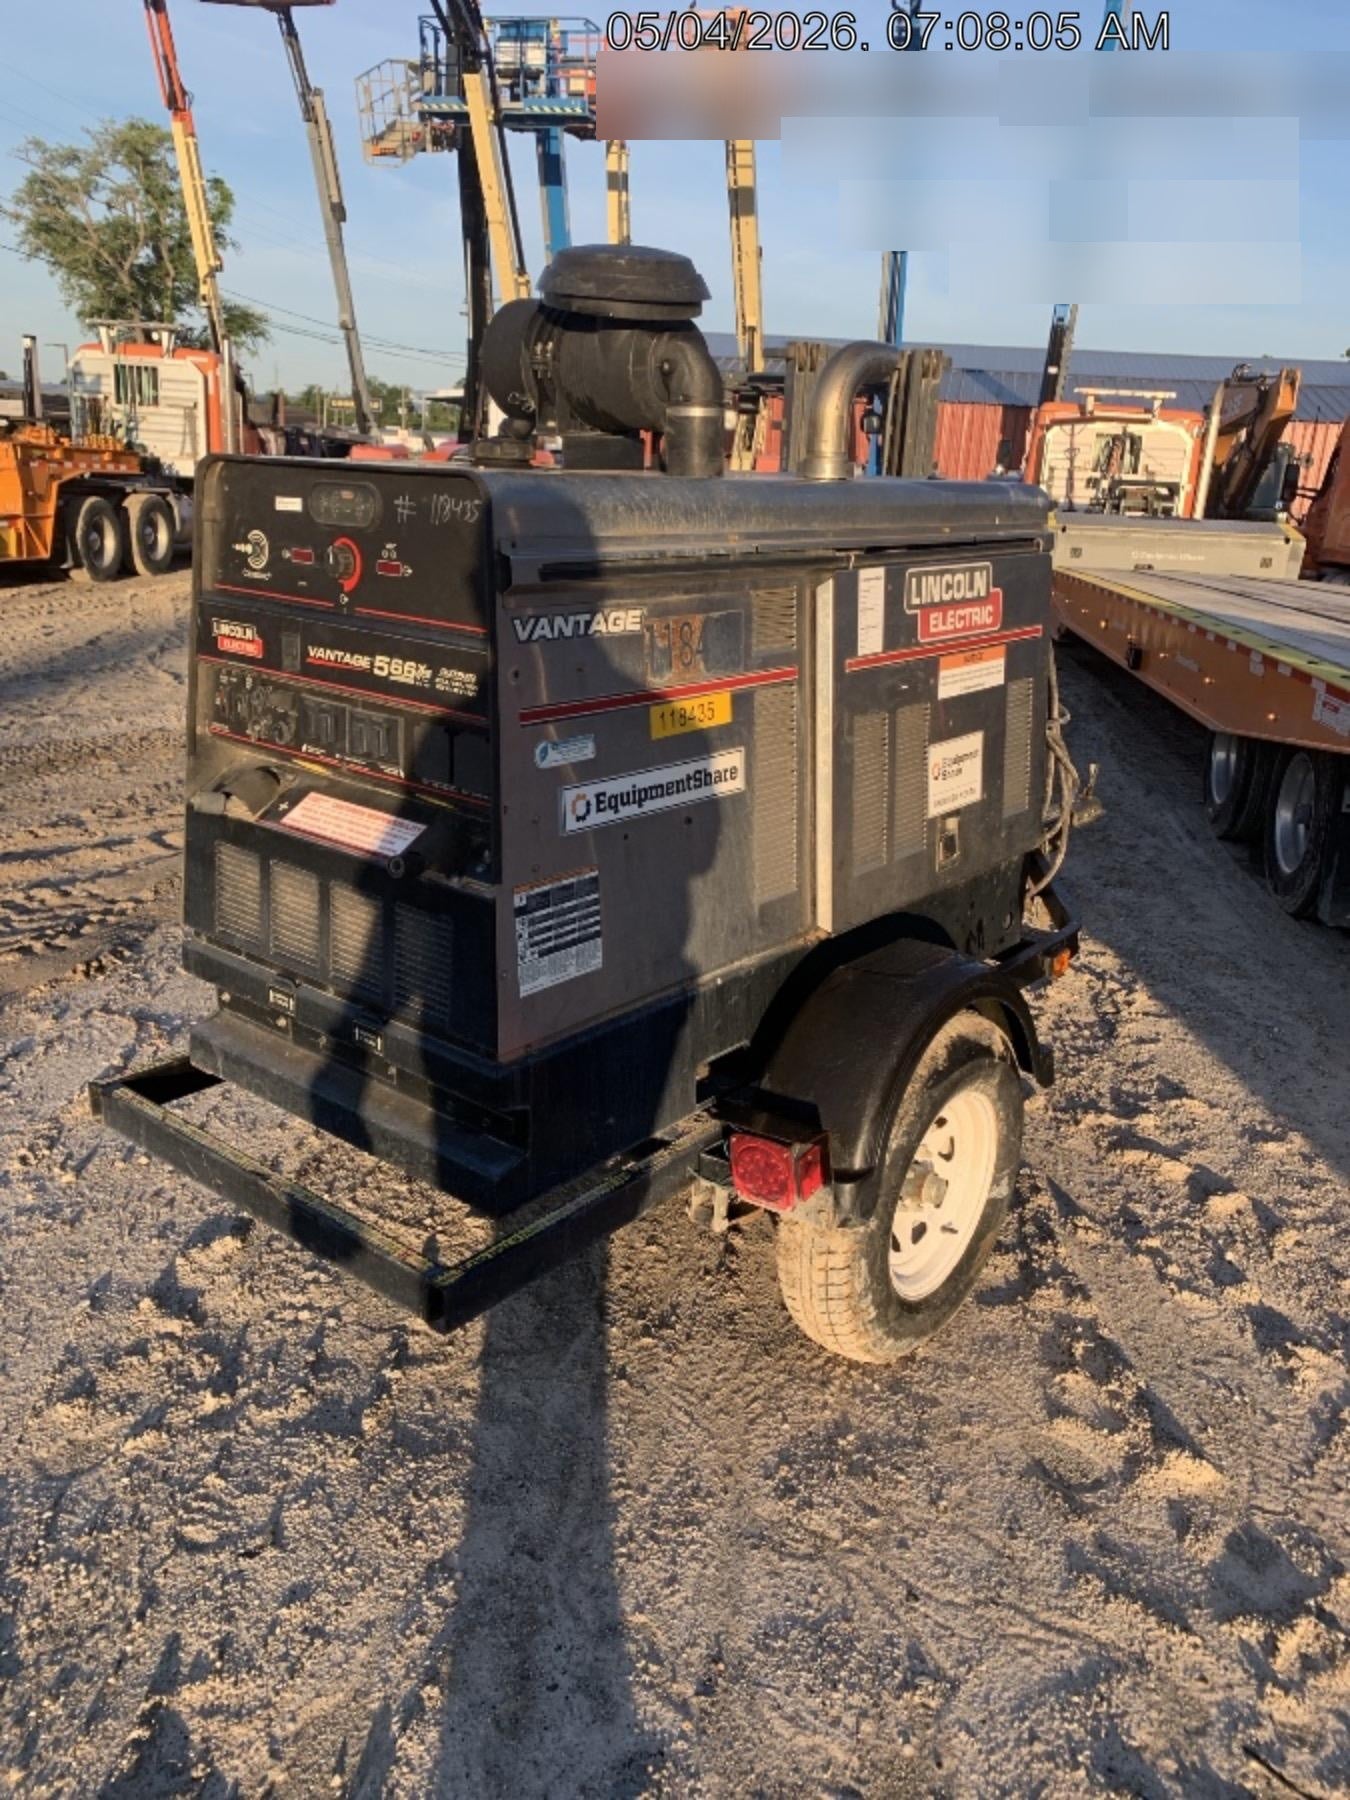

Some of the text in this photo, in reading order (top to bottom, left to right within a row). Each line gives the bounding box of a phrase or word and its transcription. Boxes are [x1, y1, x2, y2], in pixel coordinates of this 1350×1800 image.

[912, 570, 986, 605] LINCOLN
[513, 608, 644, 643] VANTAGE
[929, 605, 994, 633] ELECTRIC
[307, 646, 371, 668] VANTAGE
[659, 701, 716, 731] 118435
[596, 766, 738, 813] EquipmentShare
